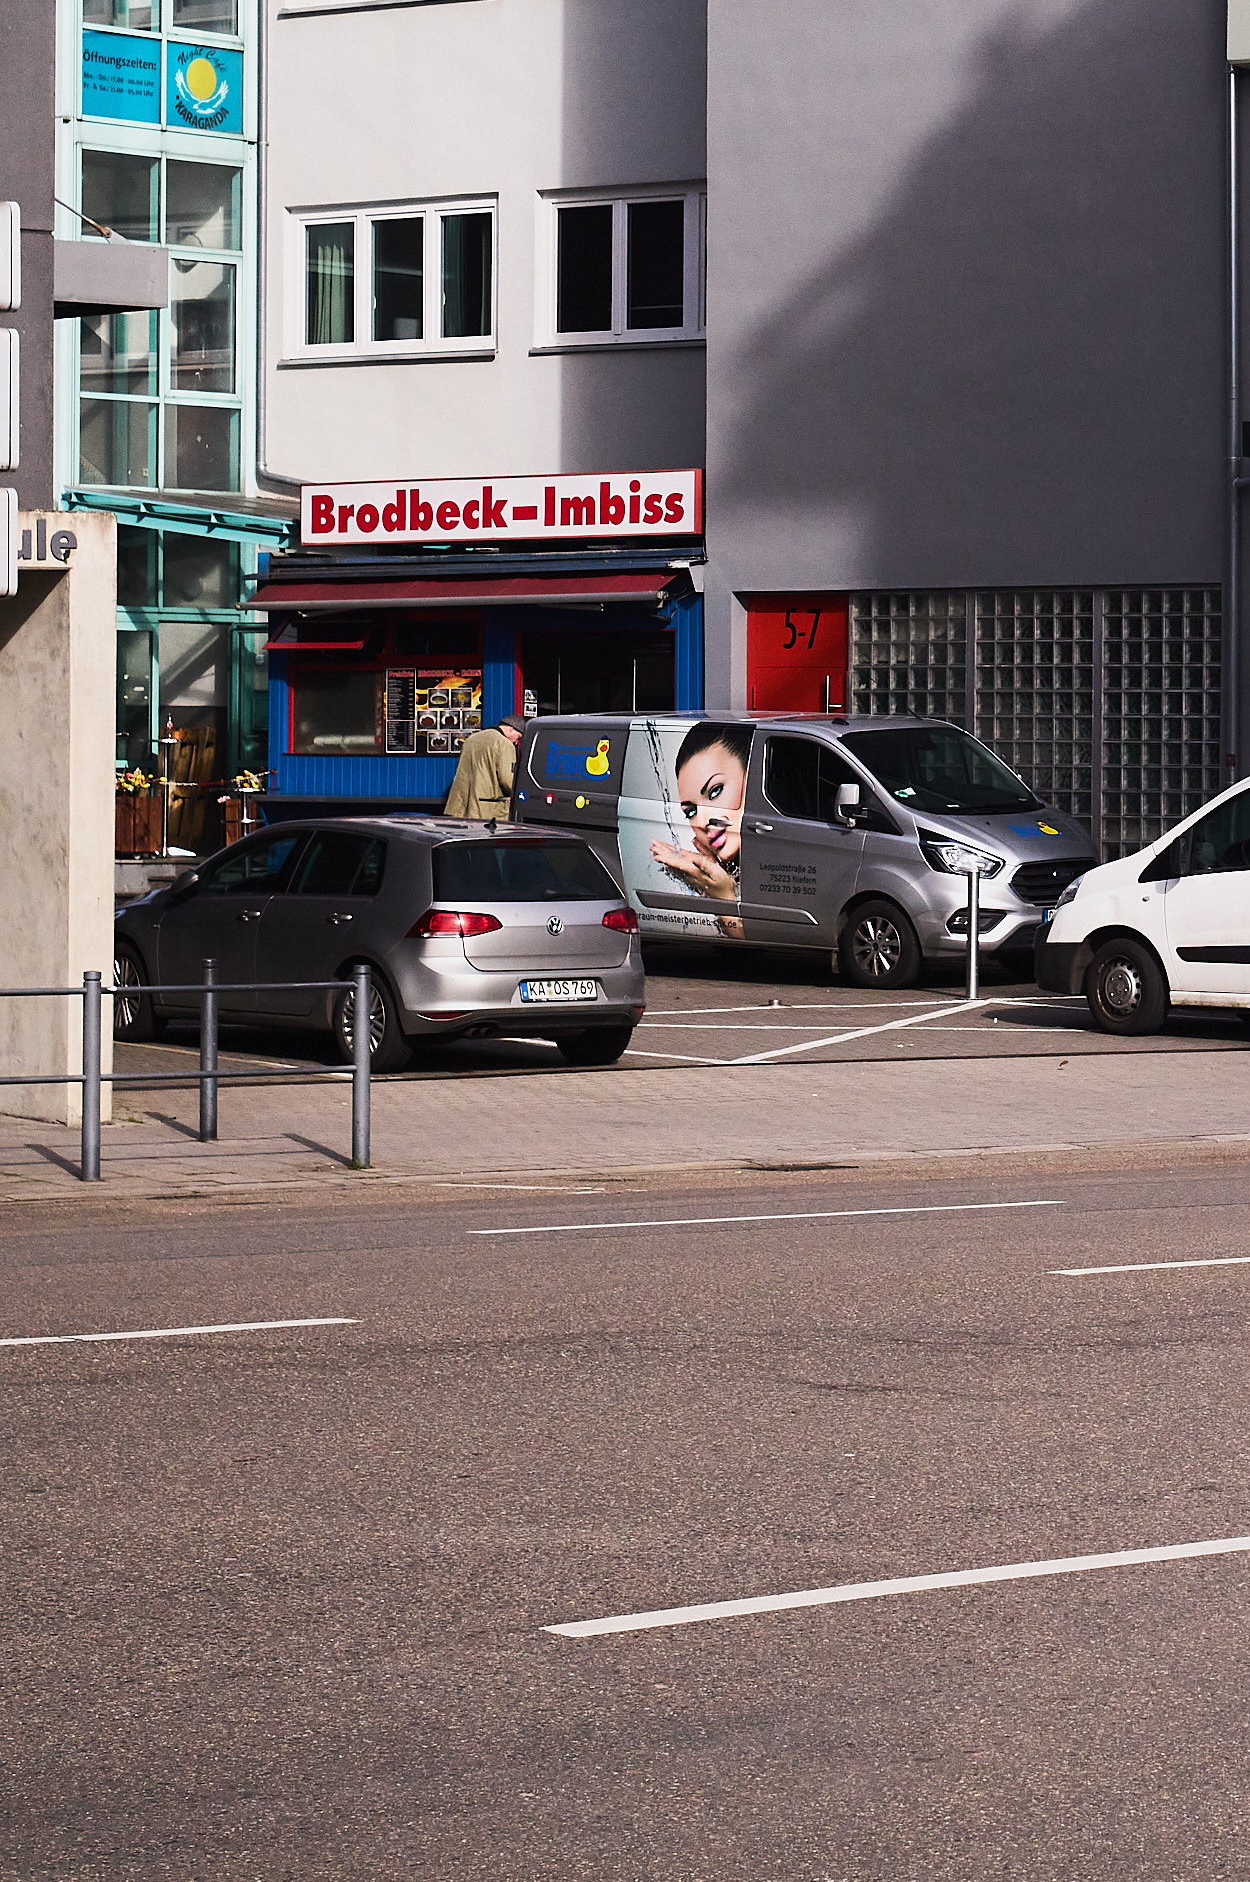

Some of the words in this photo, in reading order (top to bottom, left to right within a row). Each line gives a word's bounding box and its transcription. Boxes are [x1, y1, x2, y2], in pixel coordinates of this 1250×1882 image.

[82, 48, 157, 71] Öffnungszeiten:
[175, 99, 229, 130] KARAGANDA
[311, 479, 685, 534] Brodbeck-Imbiss
[783, 608, 821, 650] 5-7
[546, 741, 587, 775] Braun
[759, 883, 781, 893] 07233
[781, 885, 791, 894] 70
[792, 886, 802, 895] 39
[803, 887, 817, 896] 502
[770, 873, 791, 883] 75223
[529, 981, 546, 996] KA
[571, 981, 594, 995] 769
